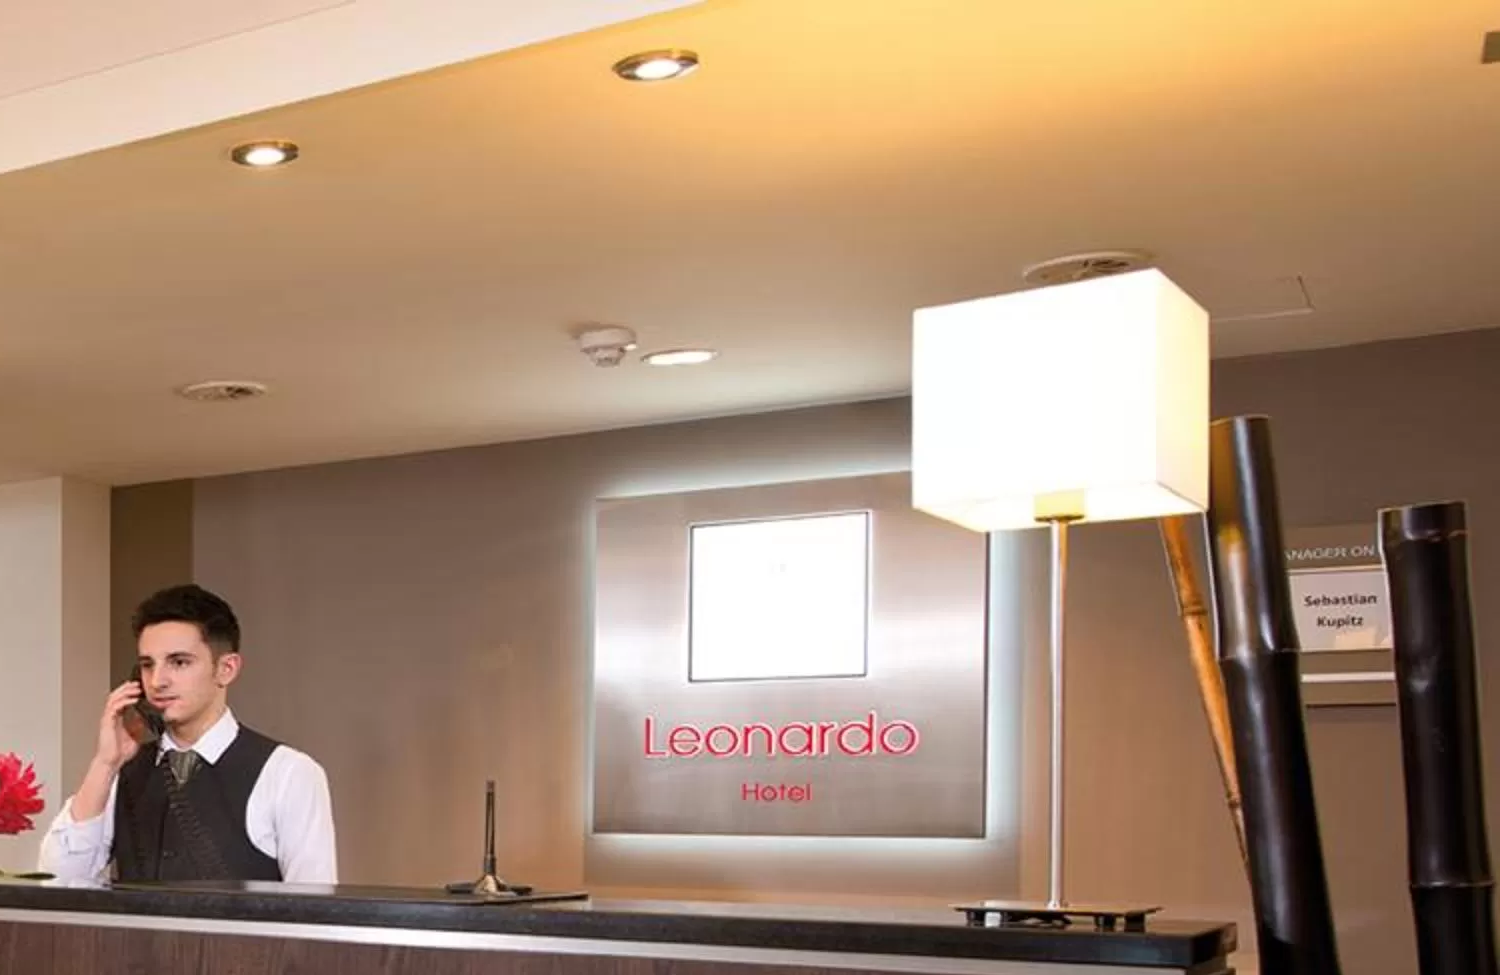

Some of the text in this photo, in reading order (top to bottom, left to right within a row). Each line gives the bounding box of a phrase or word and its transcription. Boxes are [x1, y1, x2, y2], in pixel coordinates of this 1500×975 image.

[1351, 544, 1375, 557] ON
[1304, 594, 1377, 607] Sebastian
[1316, 614, 1364, 628] Kupitz
[644, 711, 920, 758] Leonardo
[741, 782, 813, 803] Hotel
